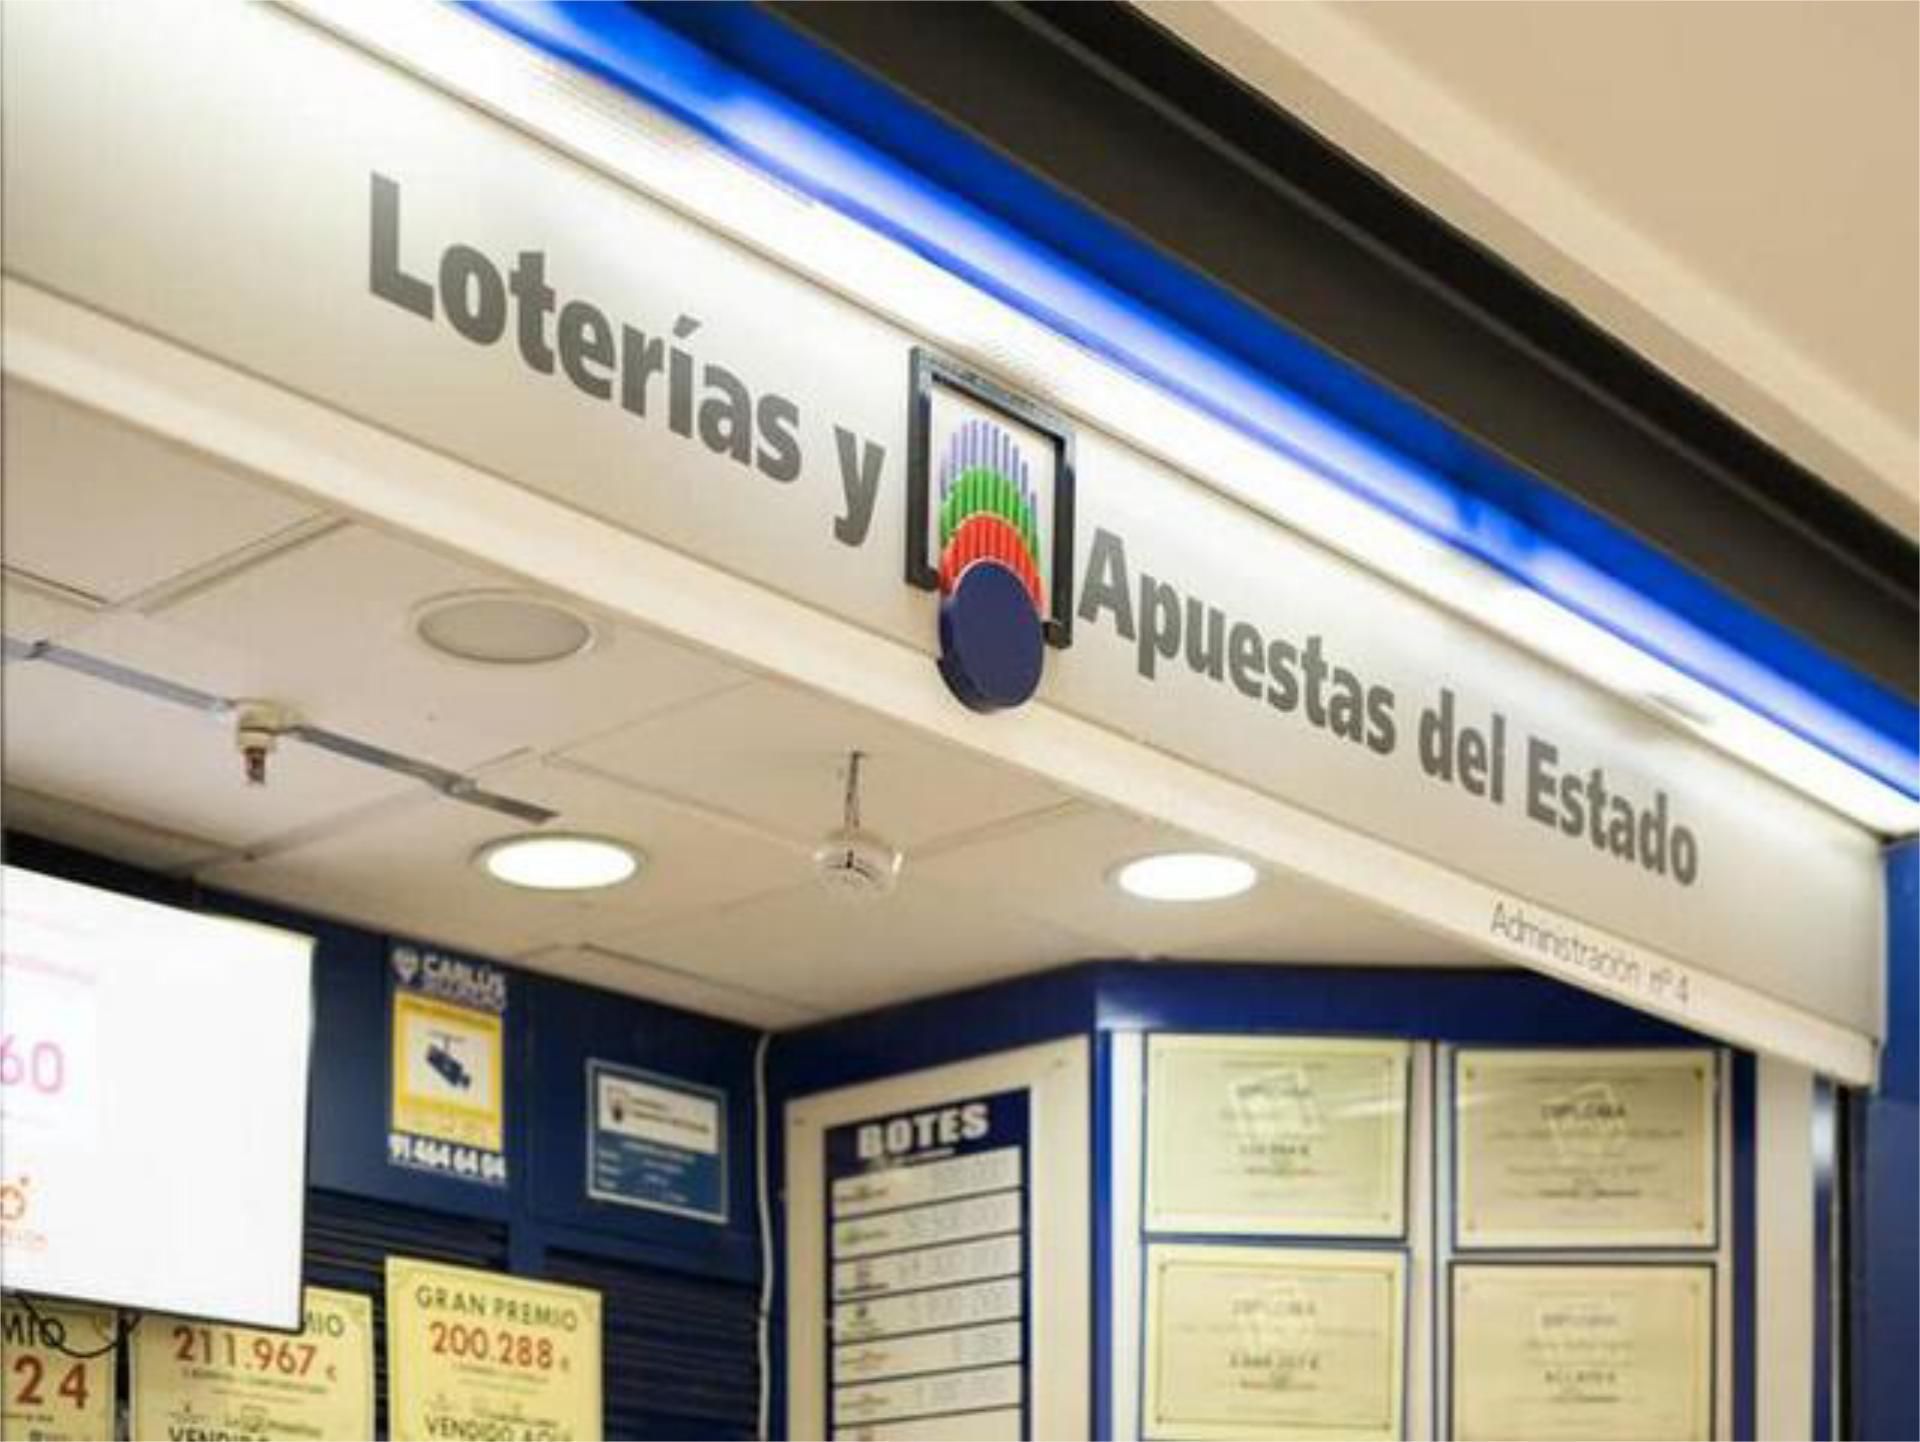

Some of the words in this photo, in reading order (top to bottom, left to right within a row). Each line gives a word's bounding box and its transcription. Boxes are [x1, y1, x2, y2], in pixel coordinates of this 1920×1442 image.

[369, 170, 803, 484] Loterías
[832, 424, 887, 548] y
[1077, 527, 1397, 756] Apuestas
[1418, 687, 1506, 805] del
[1526, 735, 1698, 887] Estado
[1490, 901, 1641, 986] Administración
[856, 1103, 990, 1159] BOTES
[415, 1284, 486, 1318] GRAN
[493, 1297, 579, 1333] PREMIO
[173, 1325, 317, 1377] 211.967
[430, 1320, 554, 1371] 200.288
